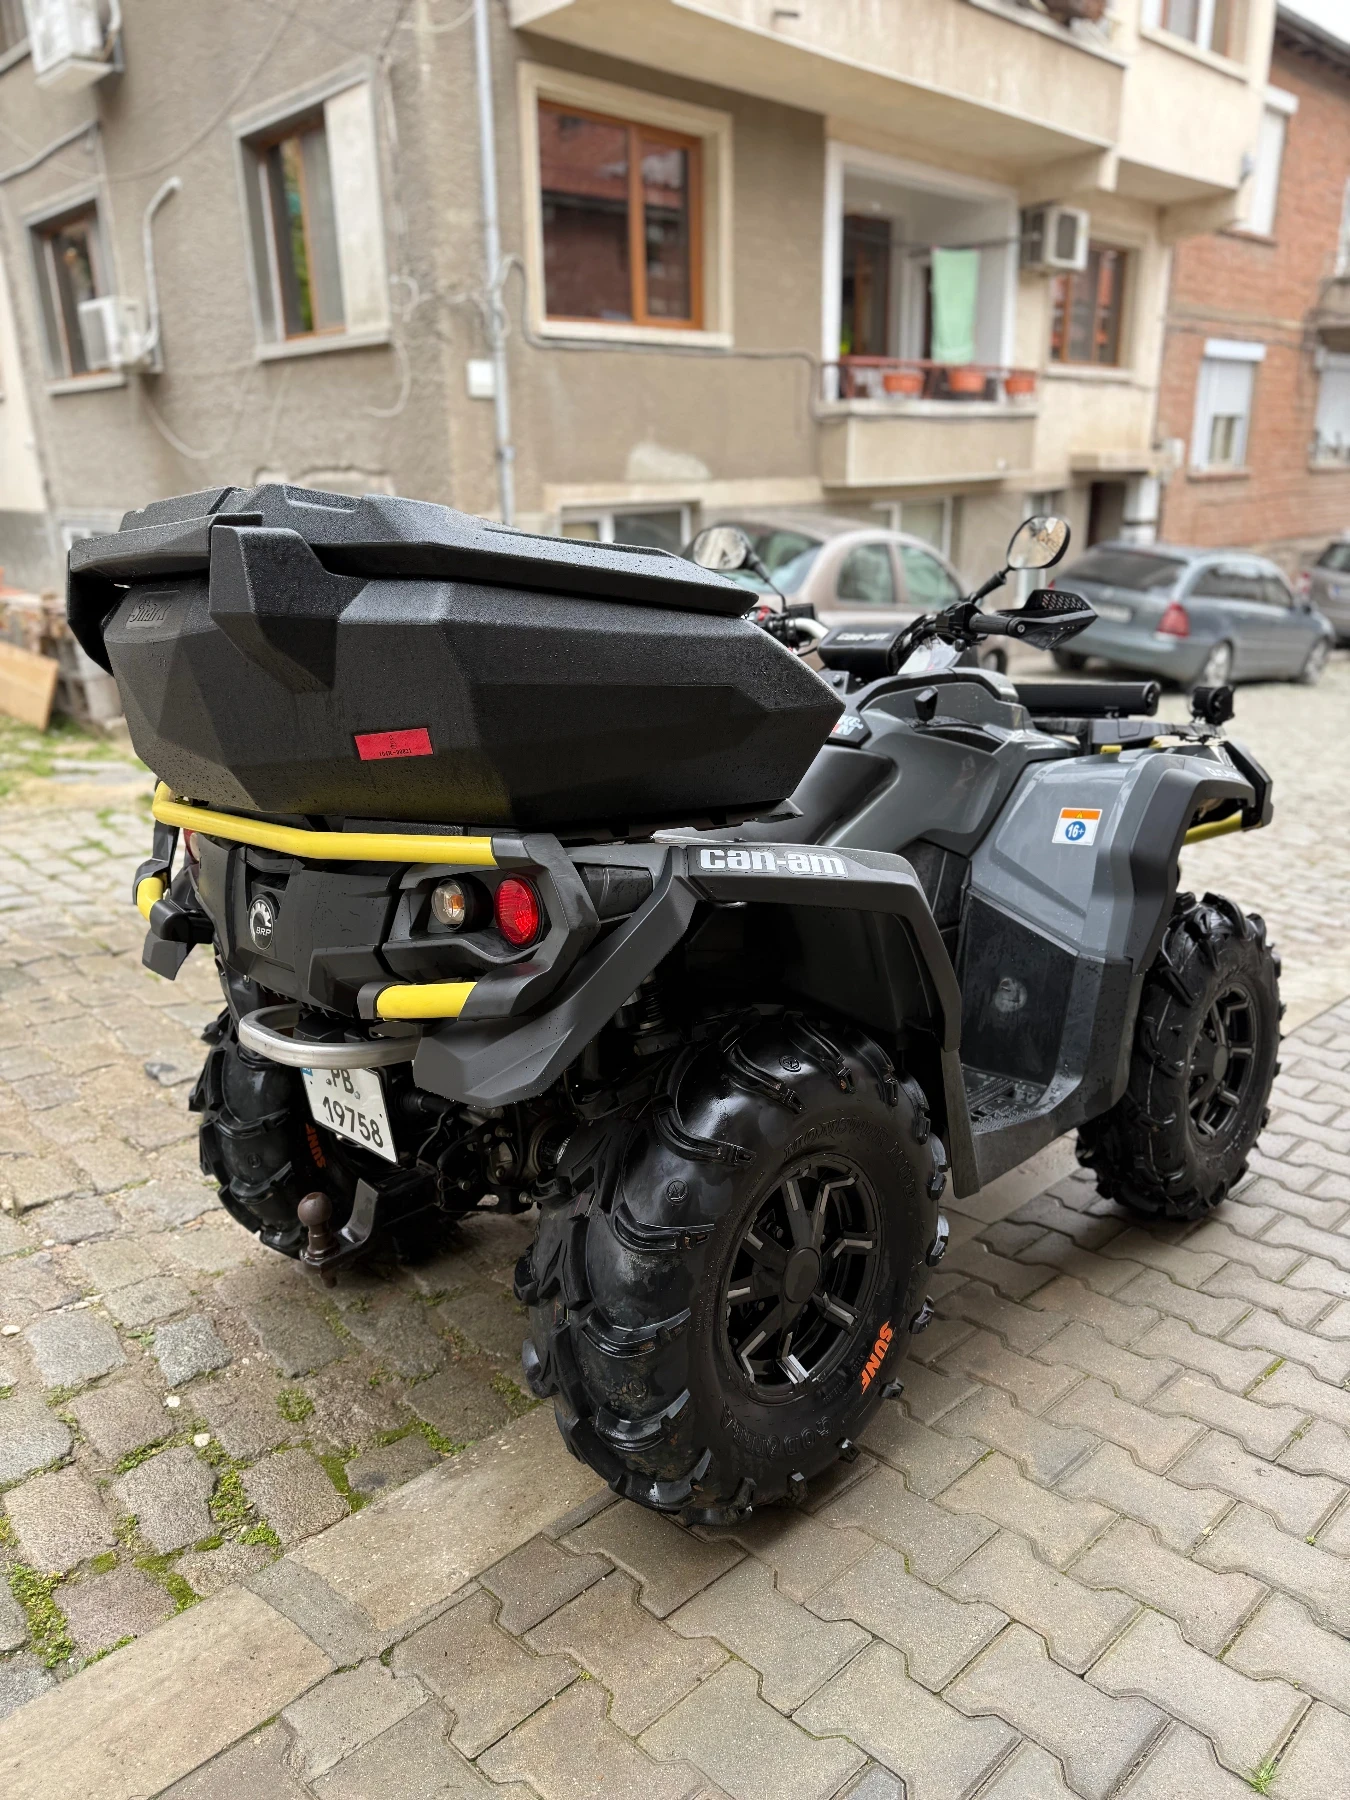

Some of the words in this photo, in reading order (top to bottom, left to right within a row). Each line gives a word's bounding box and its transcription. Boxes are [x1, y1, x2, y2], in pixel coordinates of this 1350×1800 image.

[1067, 824, 1084, 838] 16+
[700, 849, 847, 876] can-am
[256, 926, 272, 936] BRP
[330, 1068, 355, 1095] PB
[322, 1095, 384, 1149] 19758
[861, 1320, 893, 1395] SUNF
